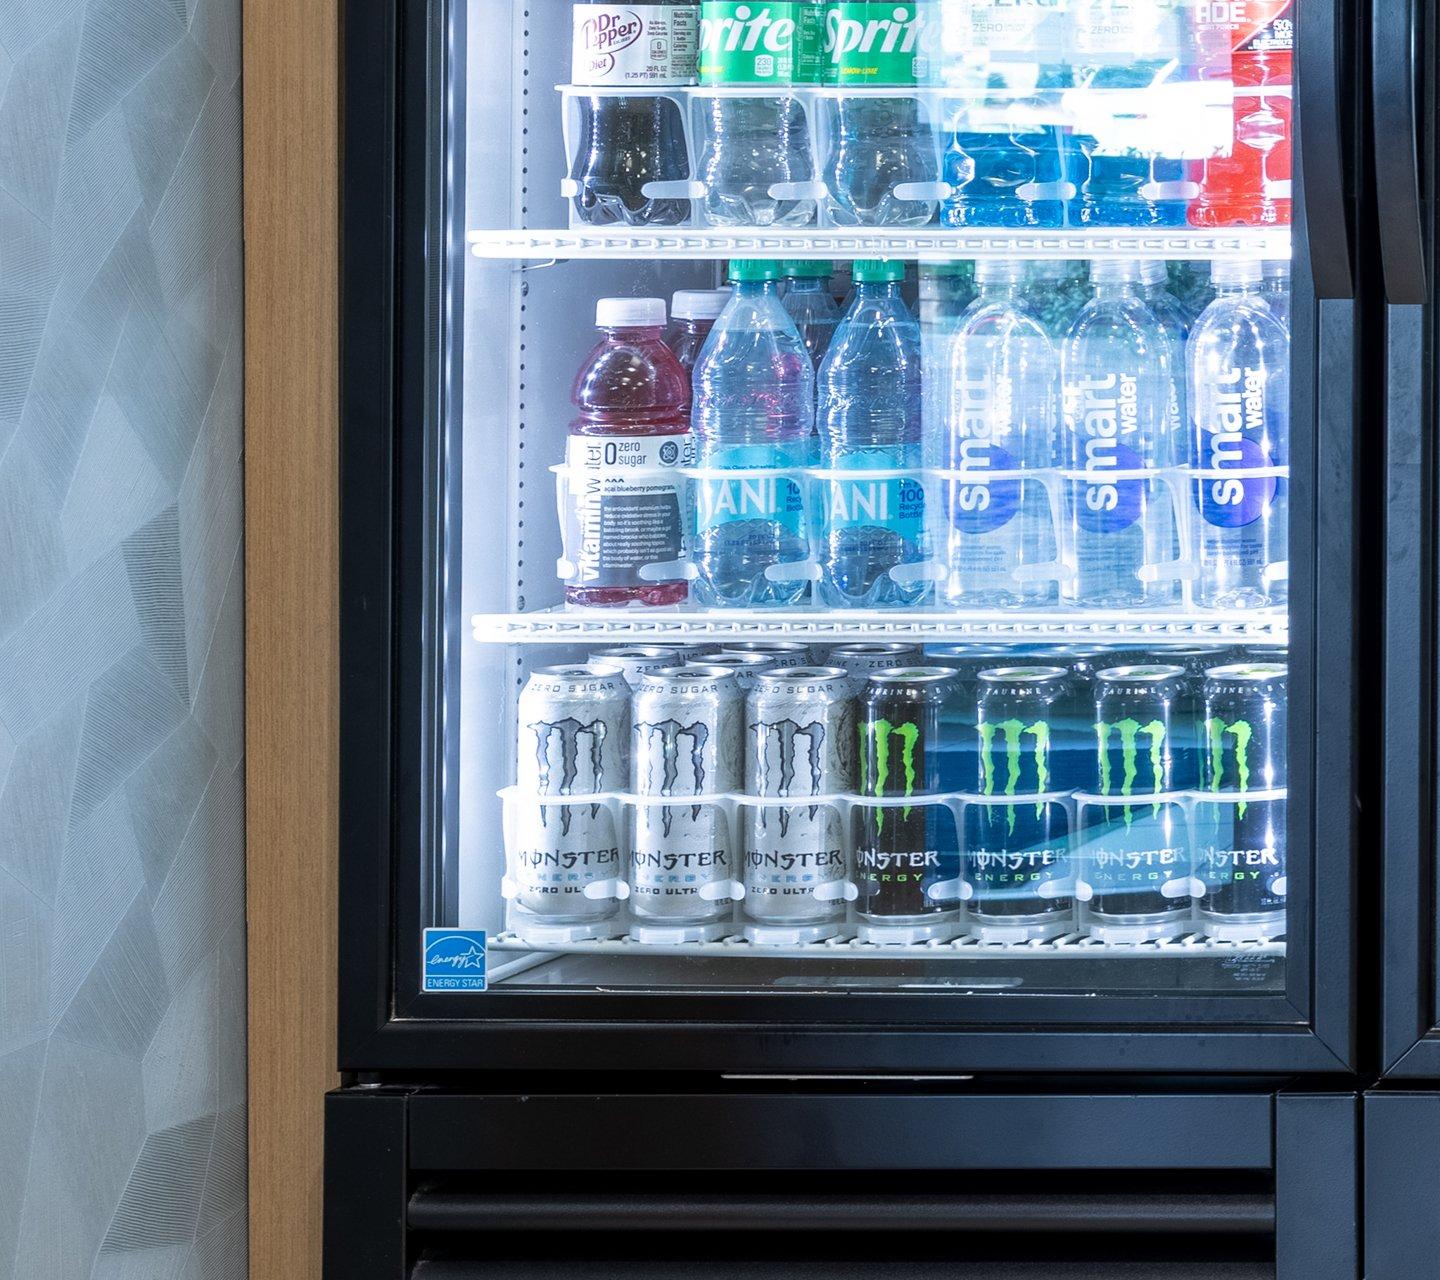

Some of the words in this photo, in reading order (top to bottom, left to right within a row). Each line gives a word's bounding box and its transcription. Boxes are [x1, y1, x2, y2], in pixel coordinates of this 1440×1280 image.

[1118, 373, 1137, 434] water
[1242, 368, 1263, 429] water
[618, 455, 647, 467] sugar
[1080, 373, 1117, 512] smart
[1212, 368, 1244, 507] smart
[427, 978, 460, 988] ENERGY
[462, 978, 484, 988] STAR
